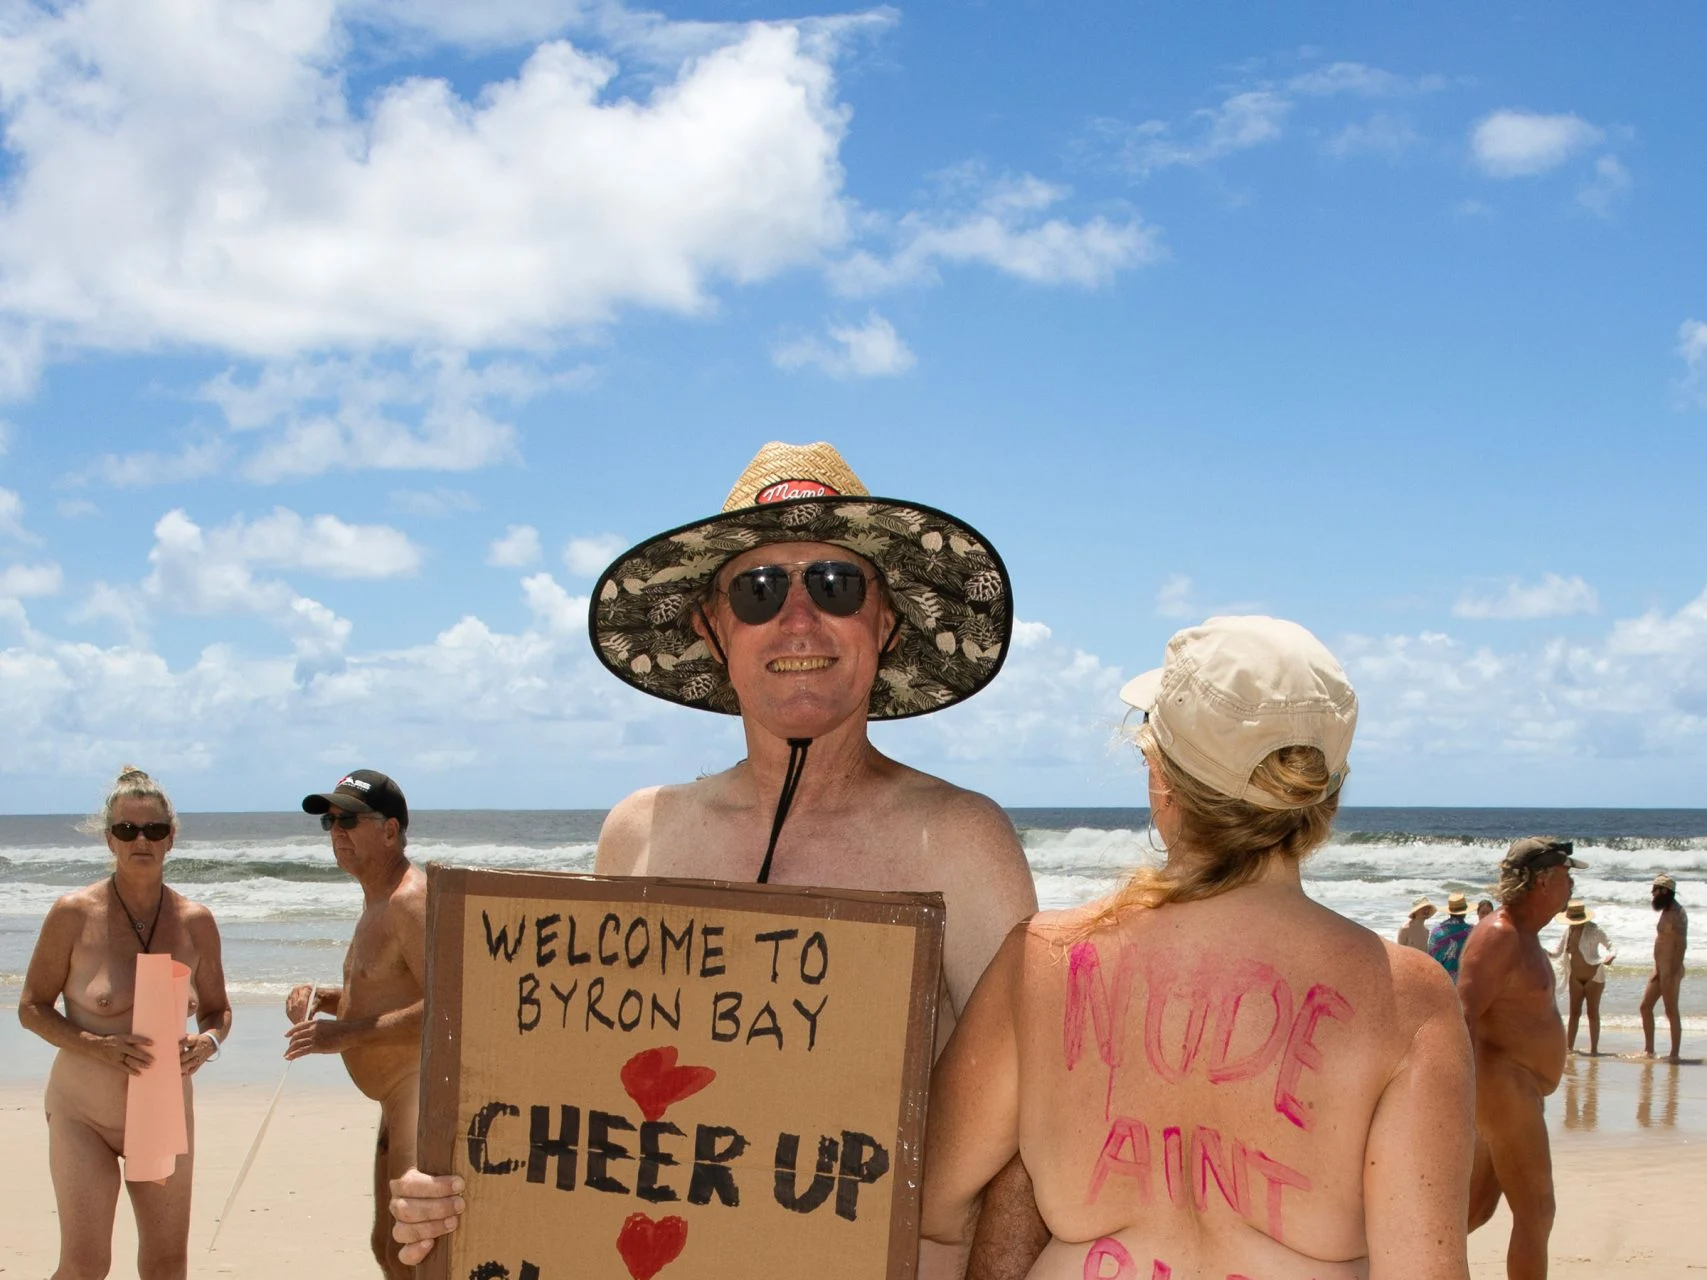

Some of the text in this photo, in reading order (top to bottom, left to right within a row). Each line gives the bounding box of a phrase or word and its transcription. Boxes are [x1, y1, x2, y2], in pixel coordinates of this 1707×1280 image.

[482, 909, 828, 984] WELCOME TO
[517, 972, 828, 1051] BYRON BAY
[1064, 942, 1355, 1130] NUDE
[467, 1101, 889, 1221] CHEER UP
[1084, 1116, 1314, 1244] AINT
